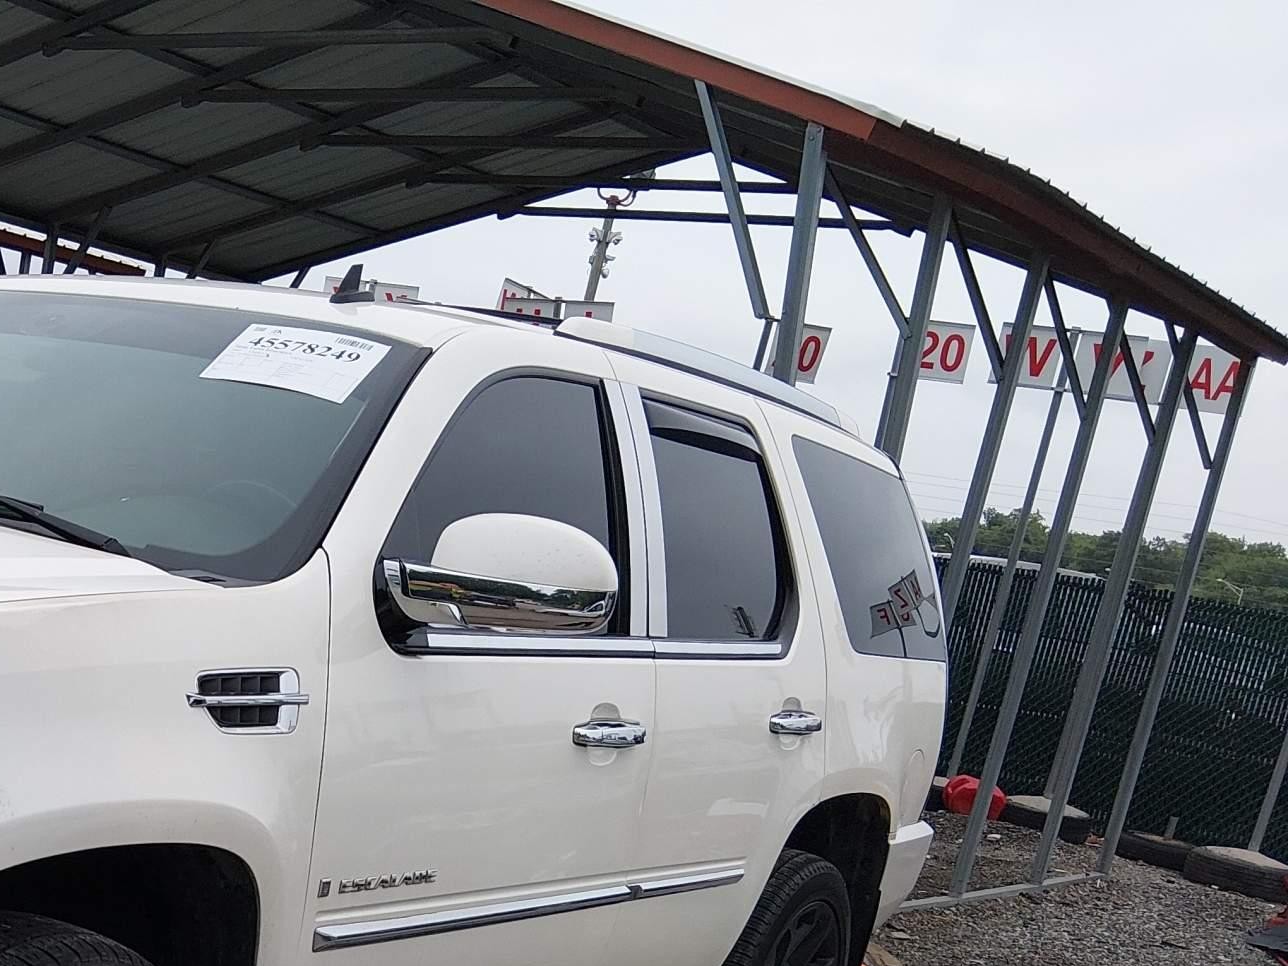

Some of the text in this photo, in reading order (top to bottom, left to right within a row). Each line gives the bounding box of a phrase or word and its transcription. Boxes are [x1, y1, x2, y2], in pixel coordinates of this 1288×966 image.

[248, 336, 361, 363] 45578249
[920, 331, 965, 372] 20
[1190, 358, 1240, 400] AA
